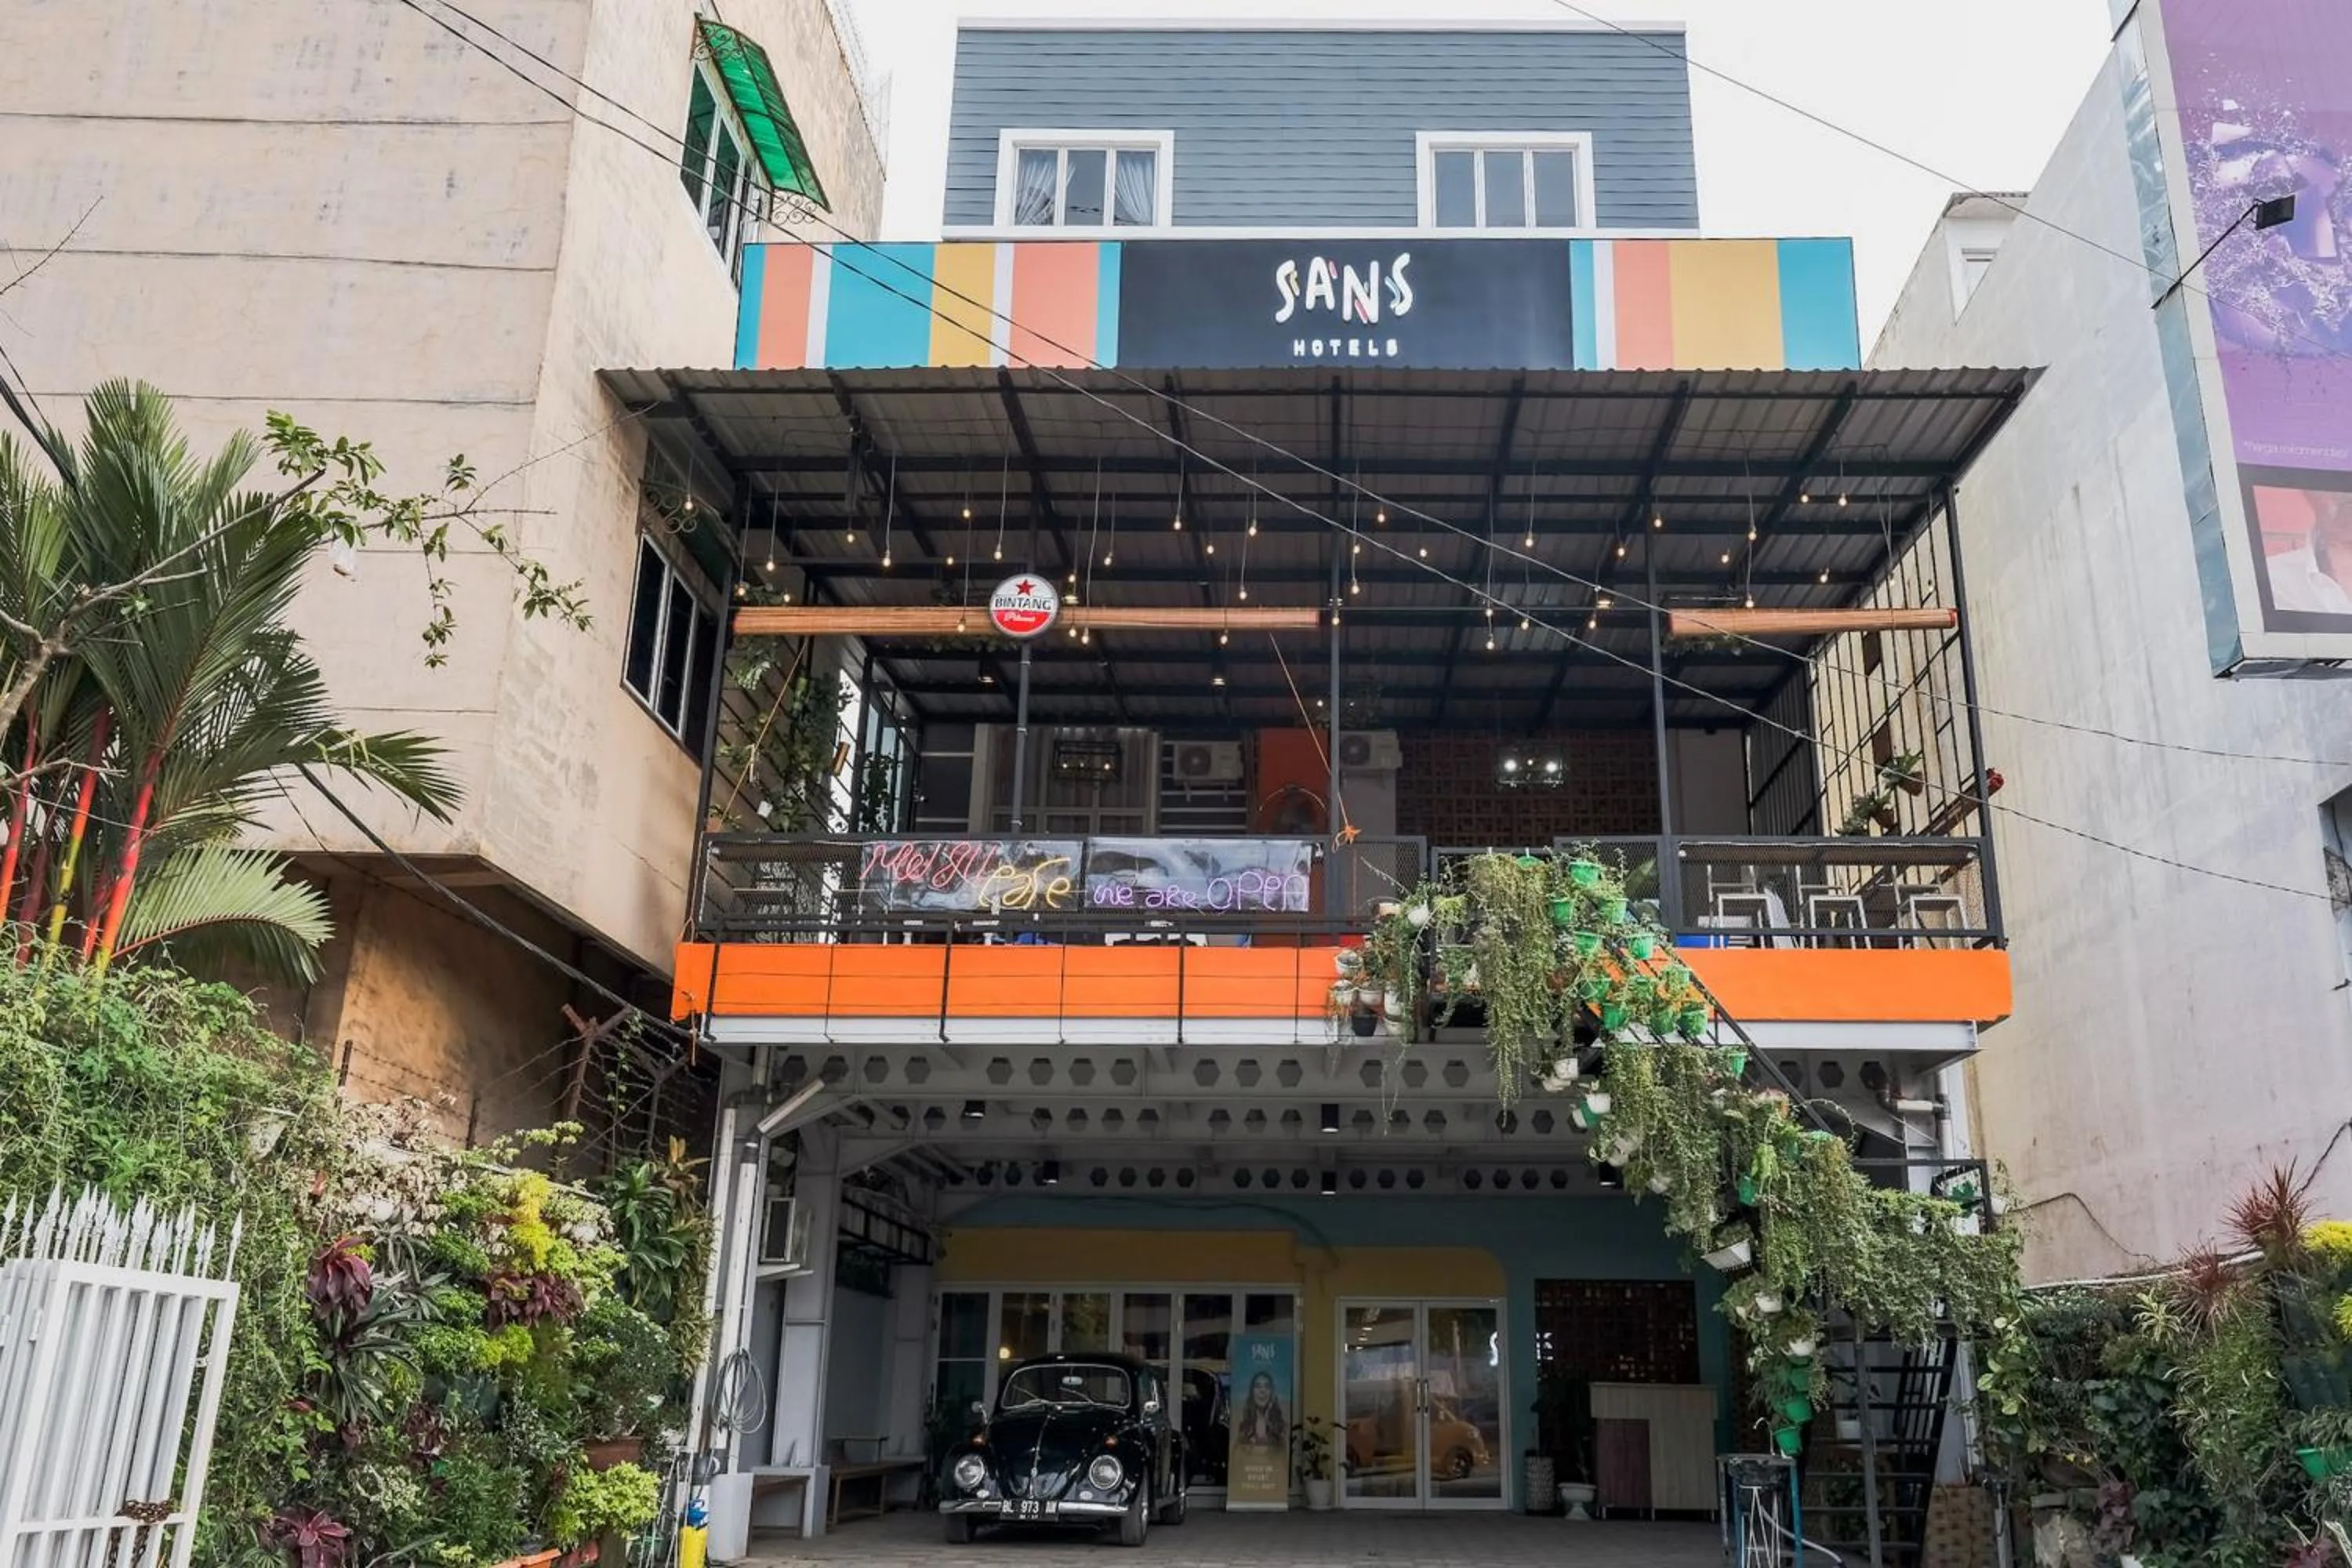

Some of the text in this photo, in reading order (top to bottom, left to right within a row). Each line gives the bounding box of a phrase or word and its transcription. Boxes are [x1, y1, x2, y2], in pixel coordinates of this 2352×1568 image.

[1276, 252, 1414, 324] SANS
[1294, 339, 1398, 357] HOTELS
[995, 597, 1051, 611] BINTANG
[1002, 1499, 1014, 1513] BL
[1021, 1499, 1040, 1514] 973
